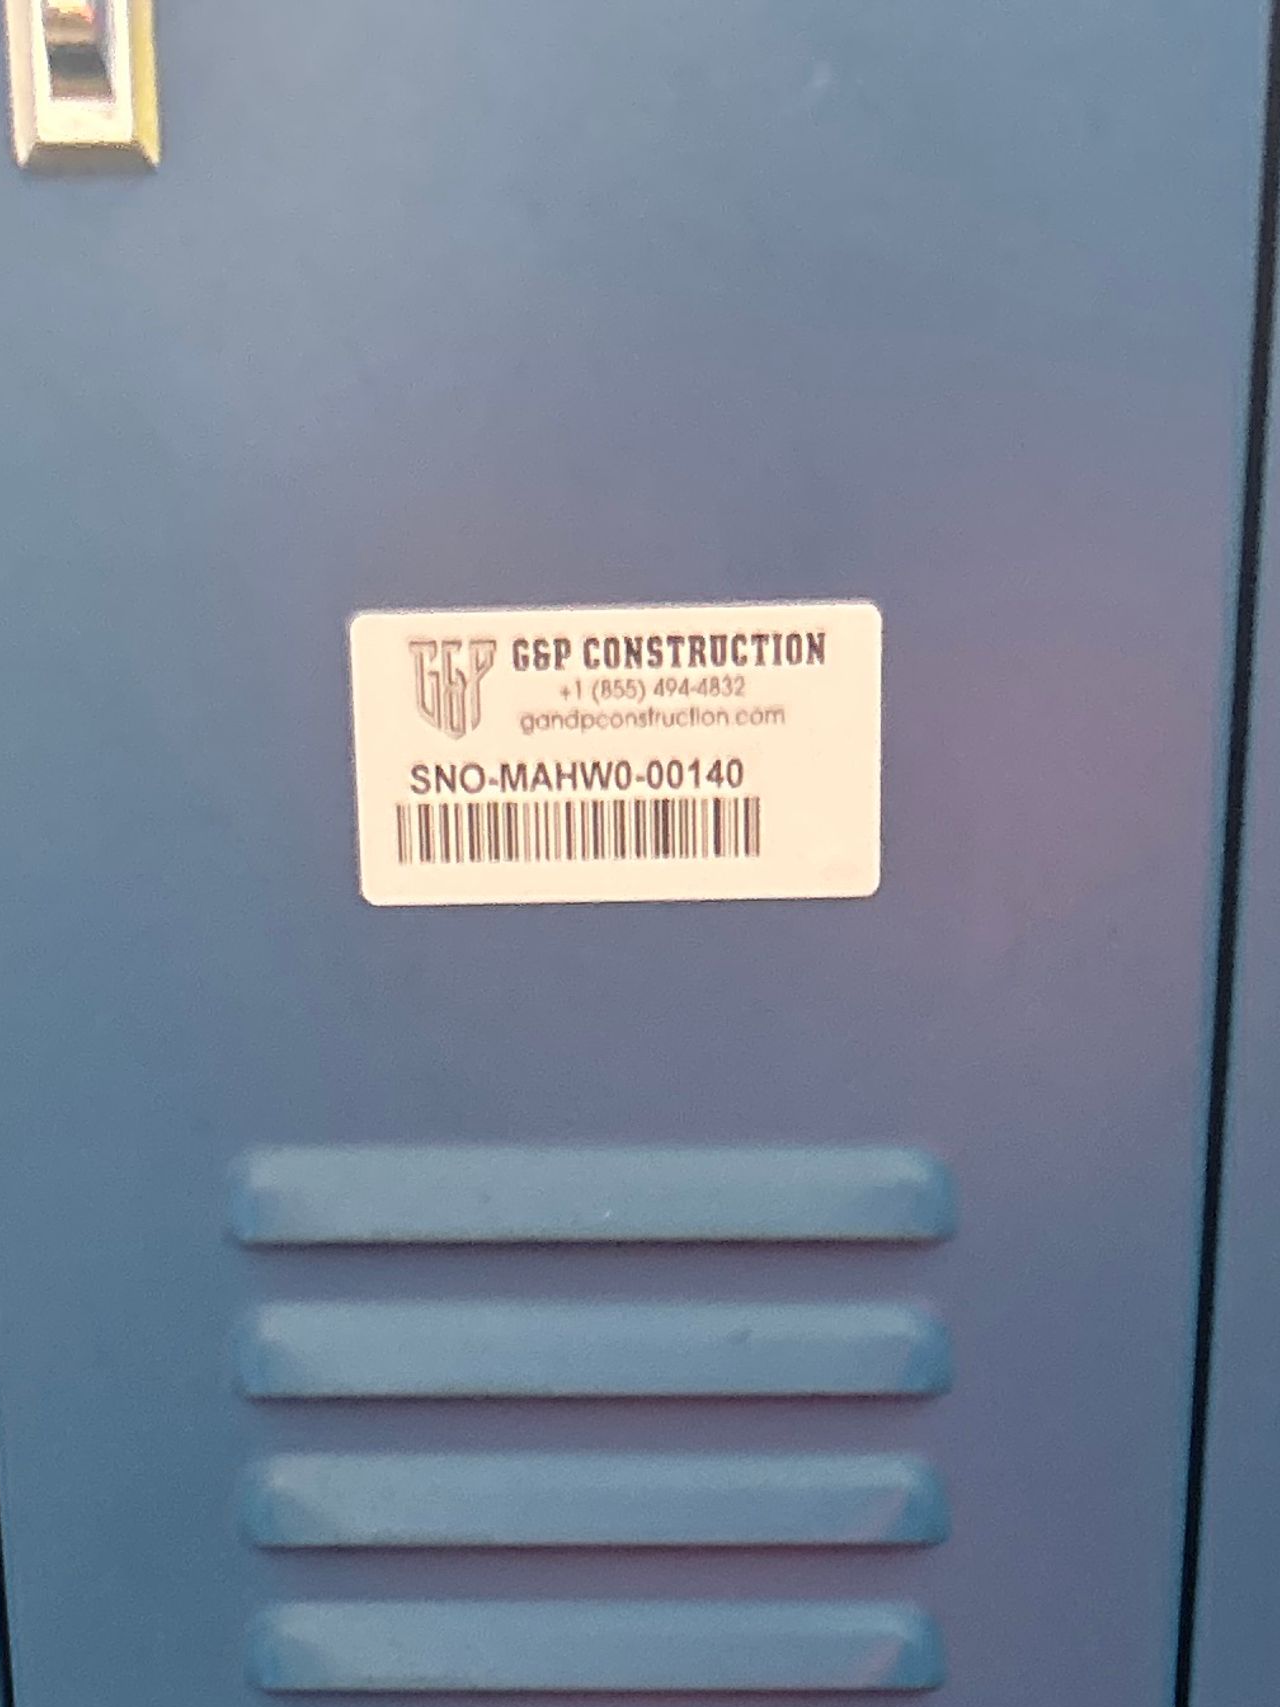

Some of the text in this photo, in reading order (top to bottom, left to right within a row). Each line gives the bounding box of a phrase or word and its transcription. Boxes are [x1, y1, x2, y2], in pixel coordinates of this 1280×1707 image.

[512, 632, 827, 672] G&P CONSTRUCTION
[560, 675, 746, 705] +1 (855) 494-4832
[519, 705, 786, 736] gandpconstruction.com
